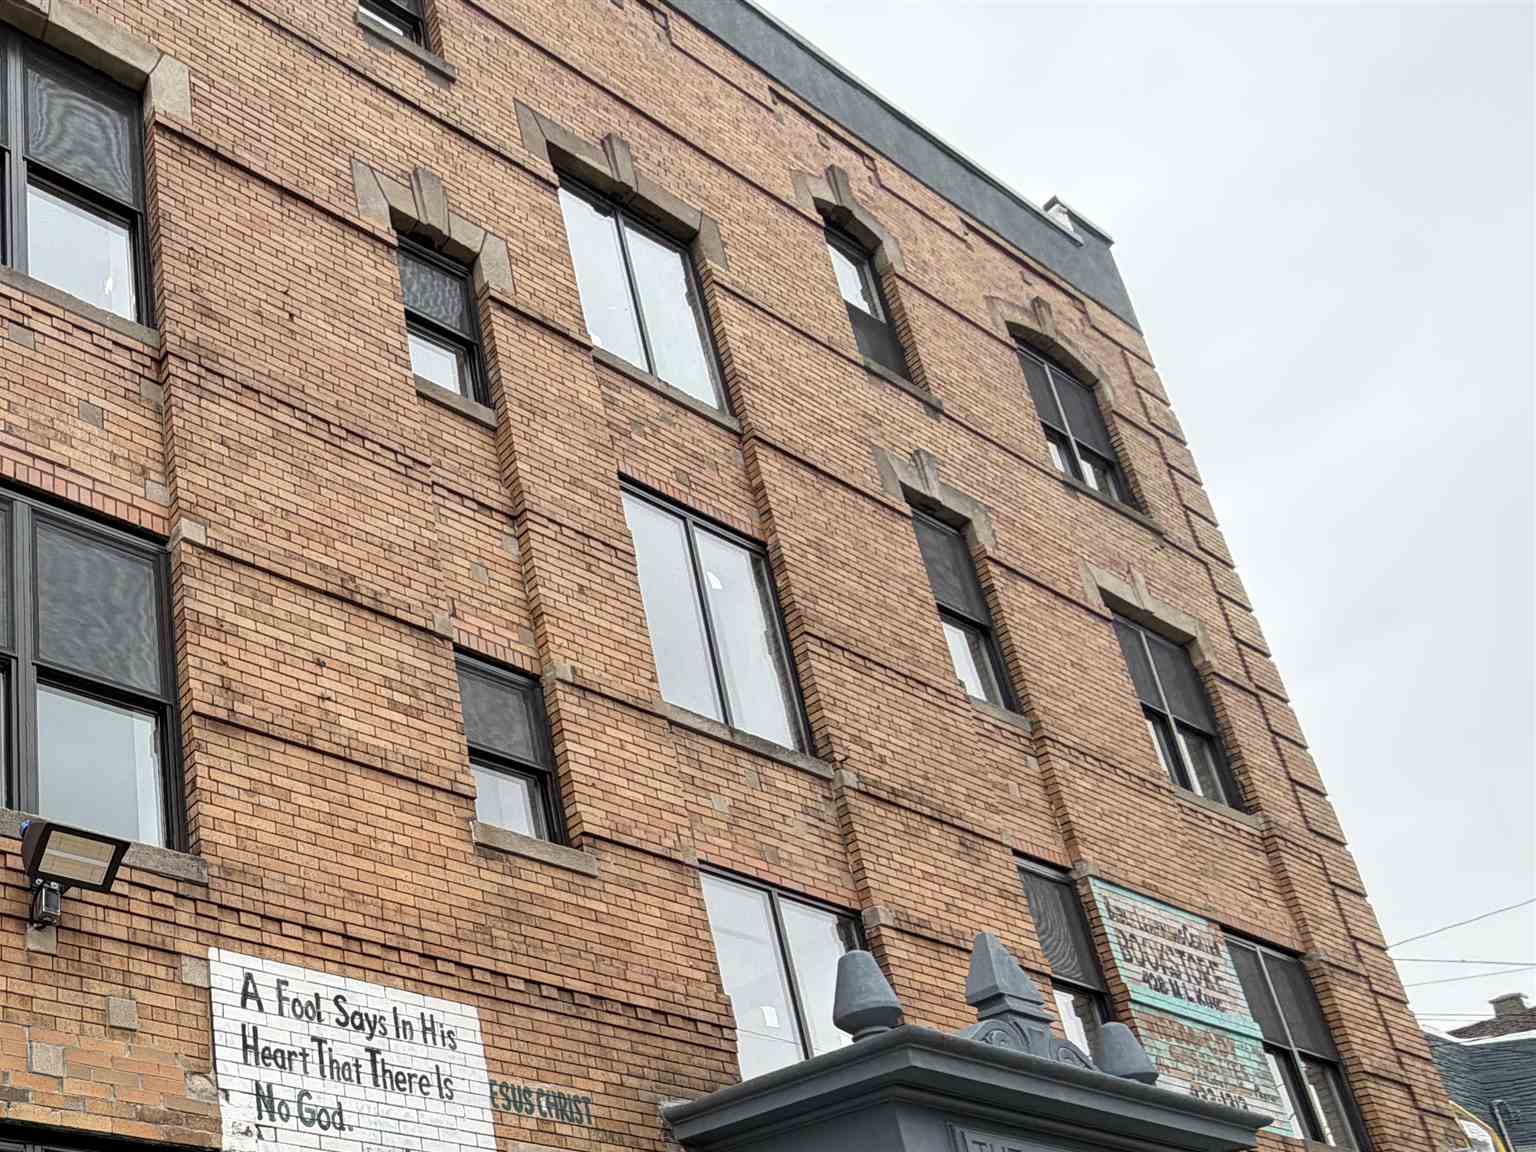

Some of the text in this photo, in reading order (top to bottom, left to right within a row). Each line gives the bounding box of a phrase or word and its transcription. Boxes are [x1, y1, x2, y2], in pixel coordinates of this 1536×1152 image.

[239, 971, 458, 1052] A Fool Says In His
[240, 1024, 455, 1101] Heart That There Is
[254, 1080, 292, 1124] No
[296, 1090, 353, 1133] God.
[537, 1087, 594, 1126] CHRIST
